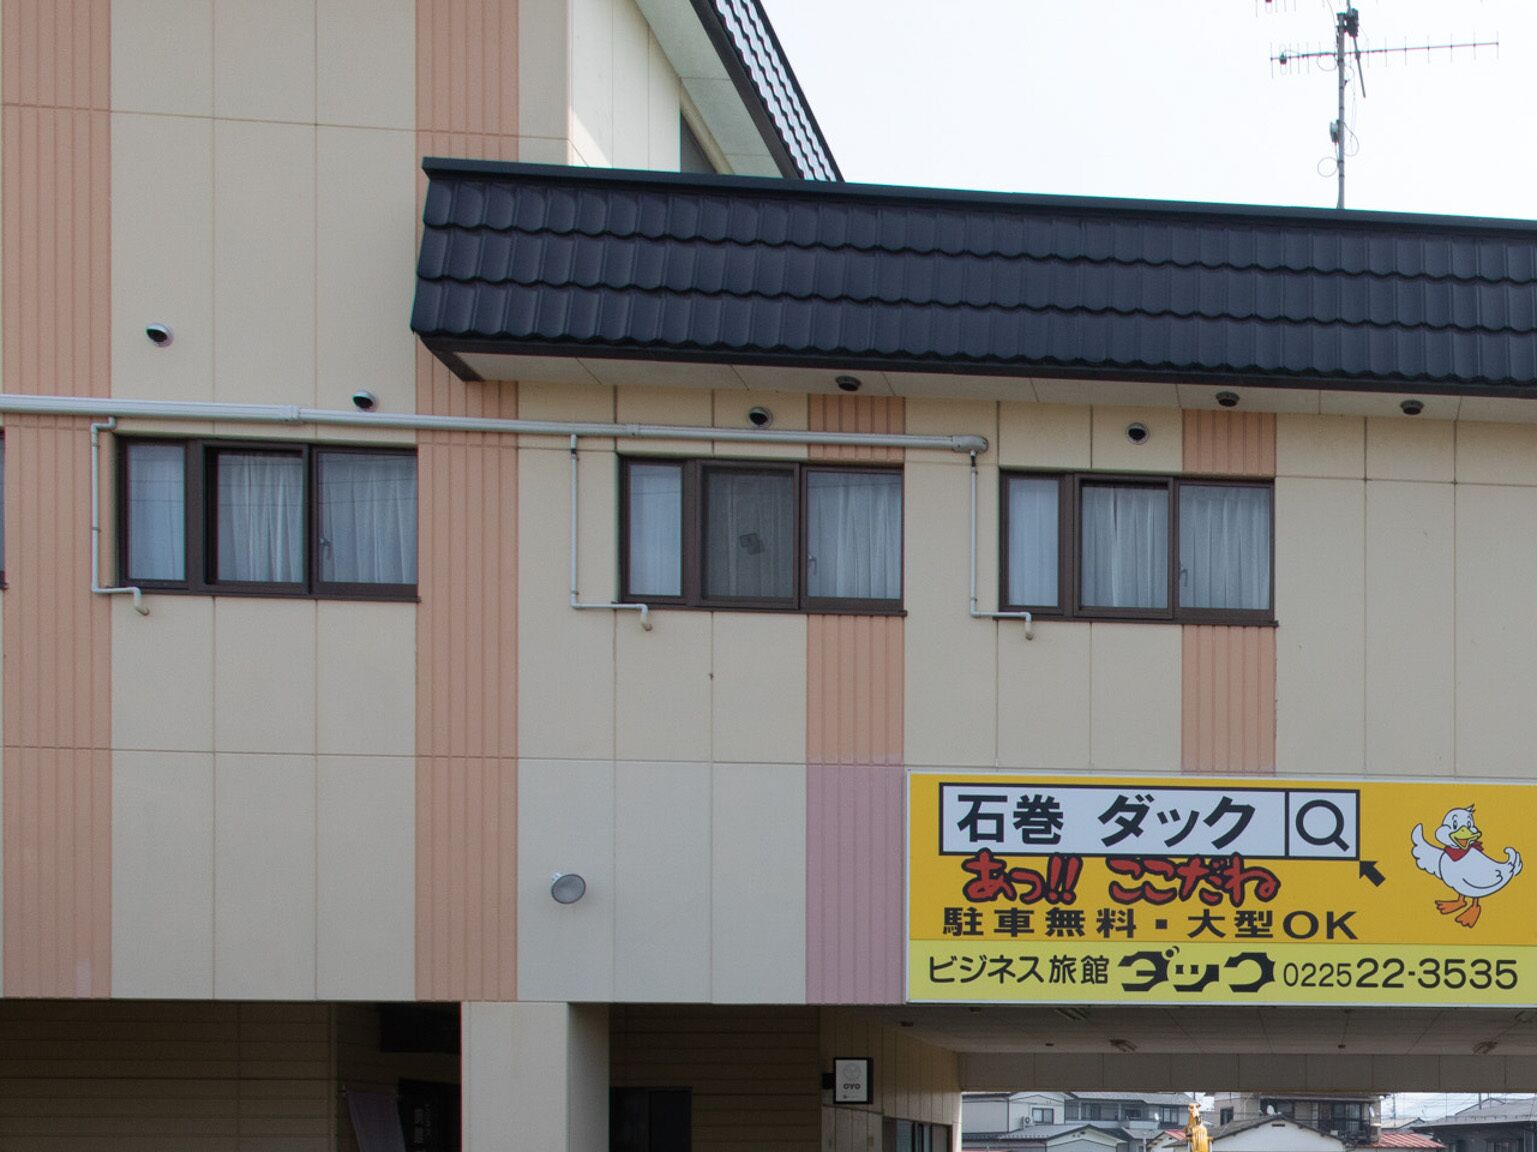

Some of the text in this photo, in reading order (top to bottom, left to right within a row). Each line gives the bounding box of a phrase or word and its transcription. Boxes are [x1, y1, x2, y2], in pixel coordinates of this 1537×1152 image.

[957, 794, 1255, 849] 石巻 ダック
[1106, 852, 1281, 907] ここだね
[930, 954, 1109, 985] ビジネス旅館
